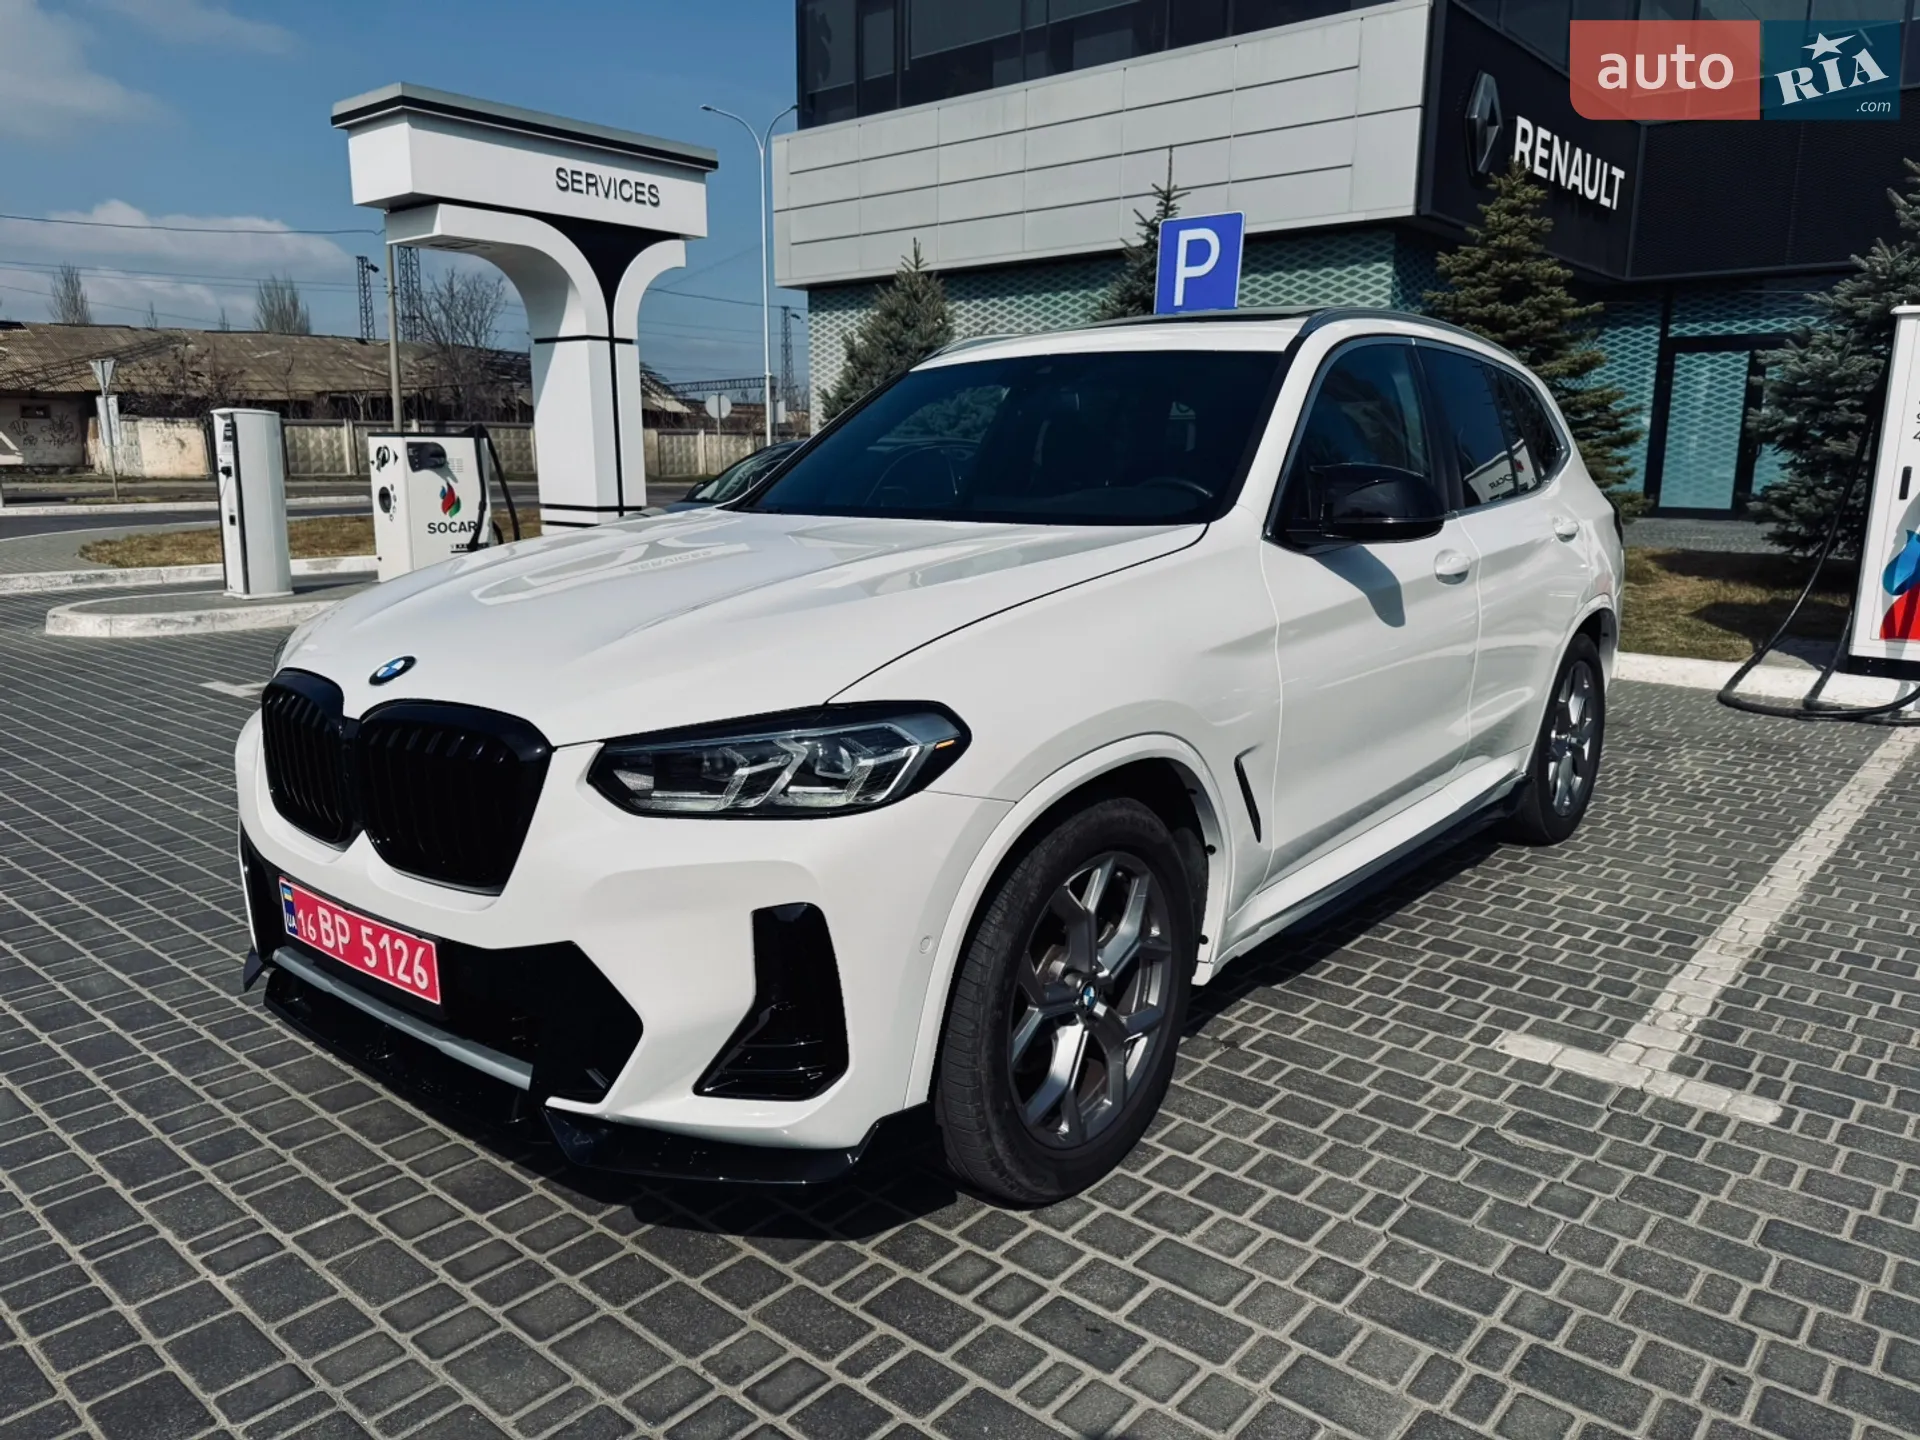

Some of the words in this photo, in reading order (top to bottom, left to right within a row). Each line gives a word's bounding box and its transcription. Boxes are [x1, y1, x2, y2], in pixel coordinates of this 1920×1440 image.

[555, 166, 660, 208] SERVICES
[1513, 115, 1625, 211] RENAULT
[1173, 228, 1220, 307] P
[427, 520, 478, 535] SOCAR
[285, 913, 298, 930] UA
[360, 924, 429, 990] 5126
